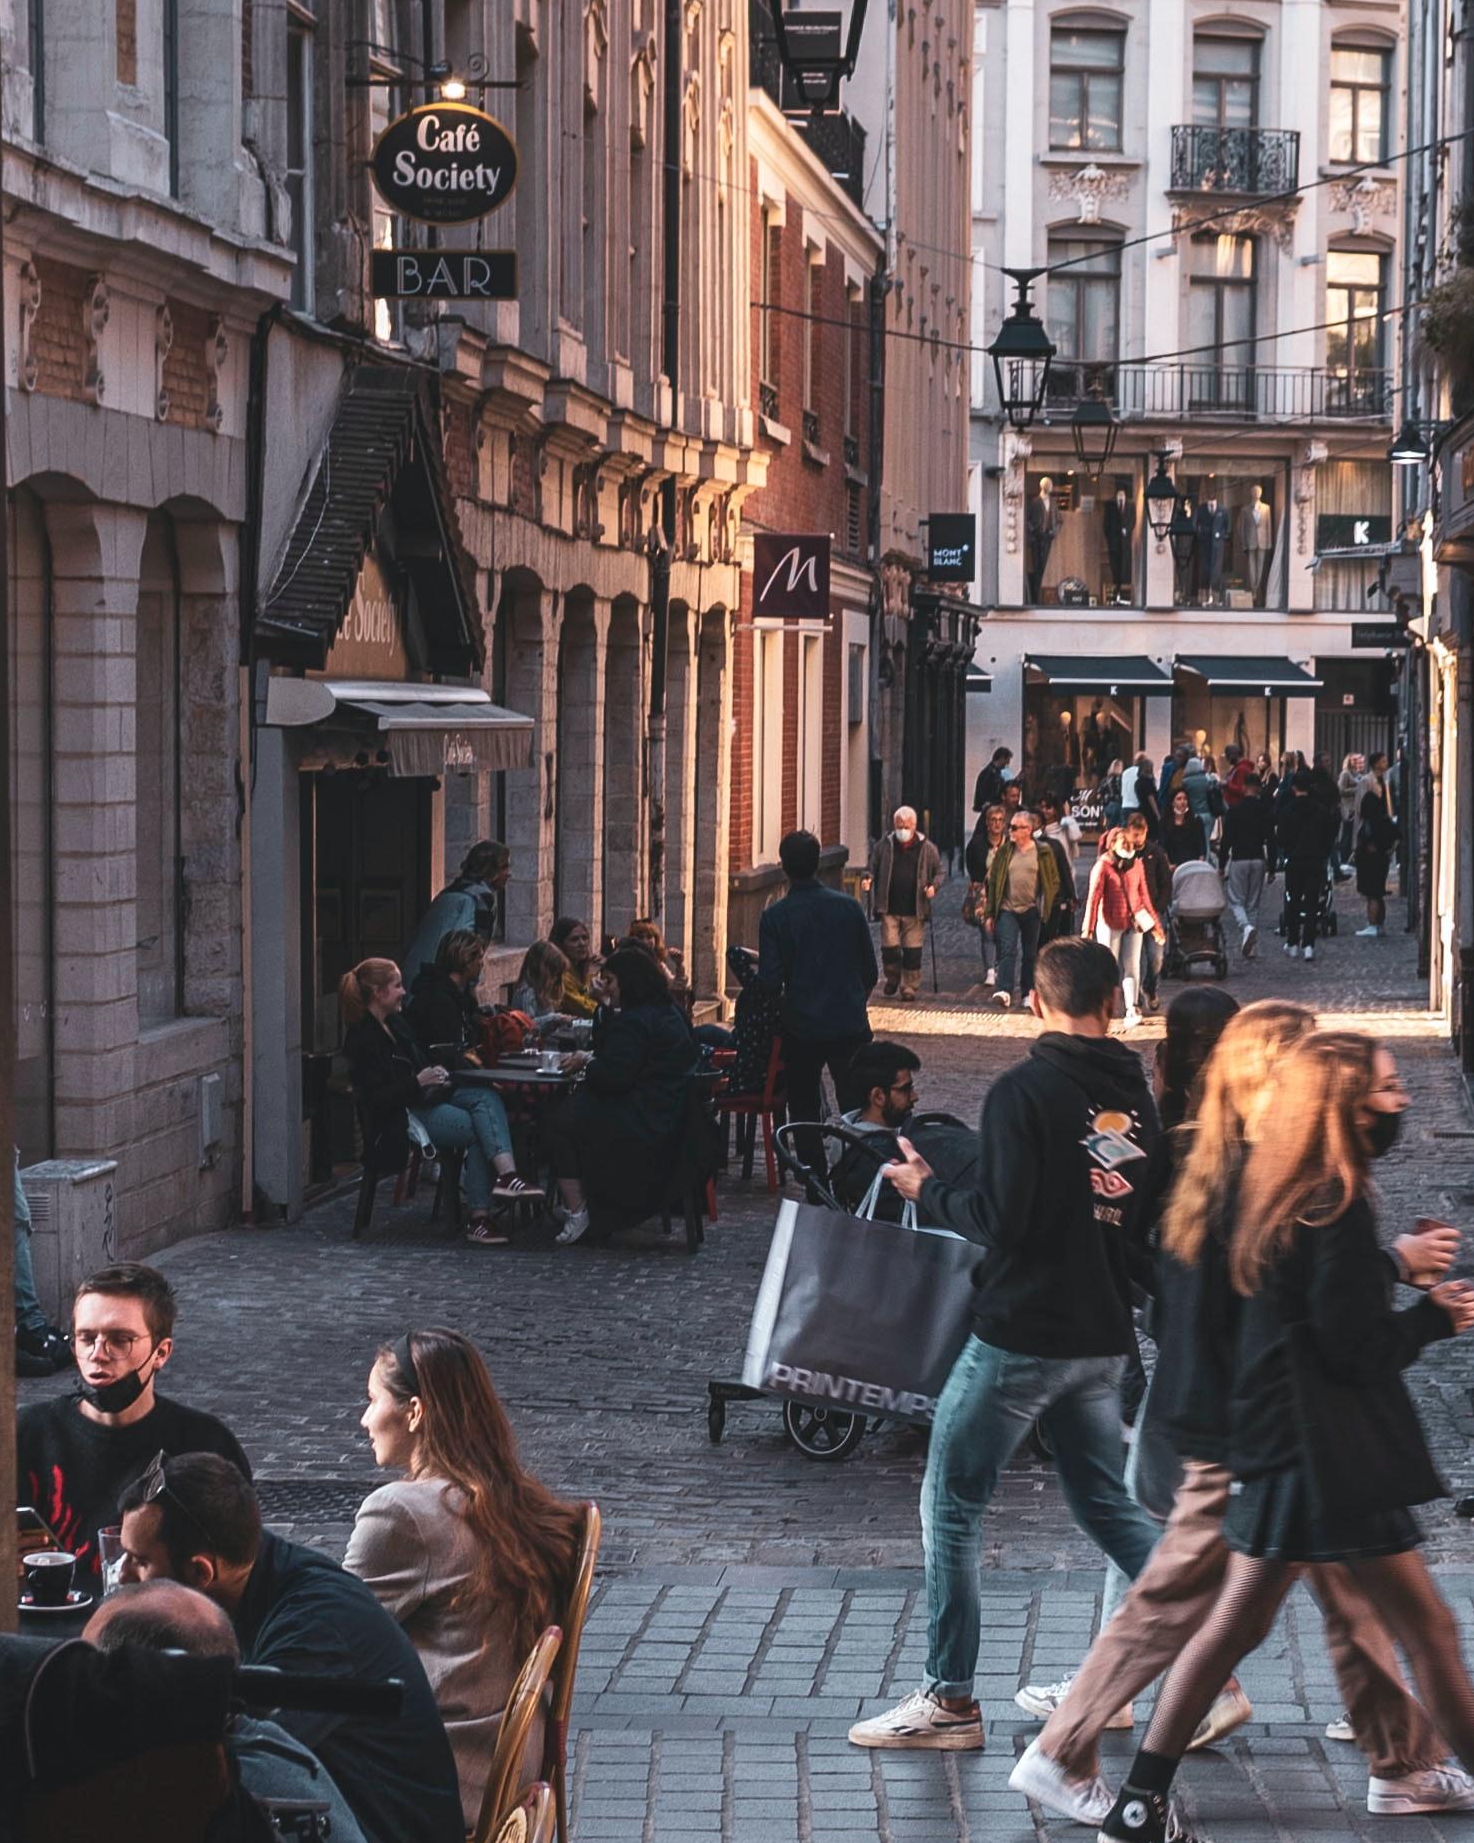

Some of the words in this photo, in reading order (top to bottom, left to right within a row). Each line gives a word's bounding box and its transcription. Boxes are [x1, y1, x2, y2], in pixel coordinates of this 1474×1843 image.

[417, 114, 480, 153] Café
[393, 150, 501, 195] Society
[396, 256, 491, 295] BAR
[1353, 520, 1370, 545] K
[933, 548, 961, 557] MONT
[933, 557, 962, 566] BLANC
